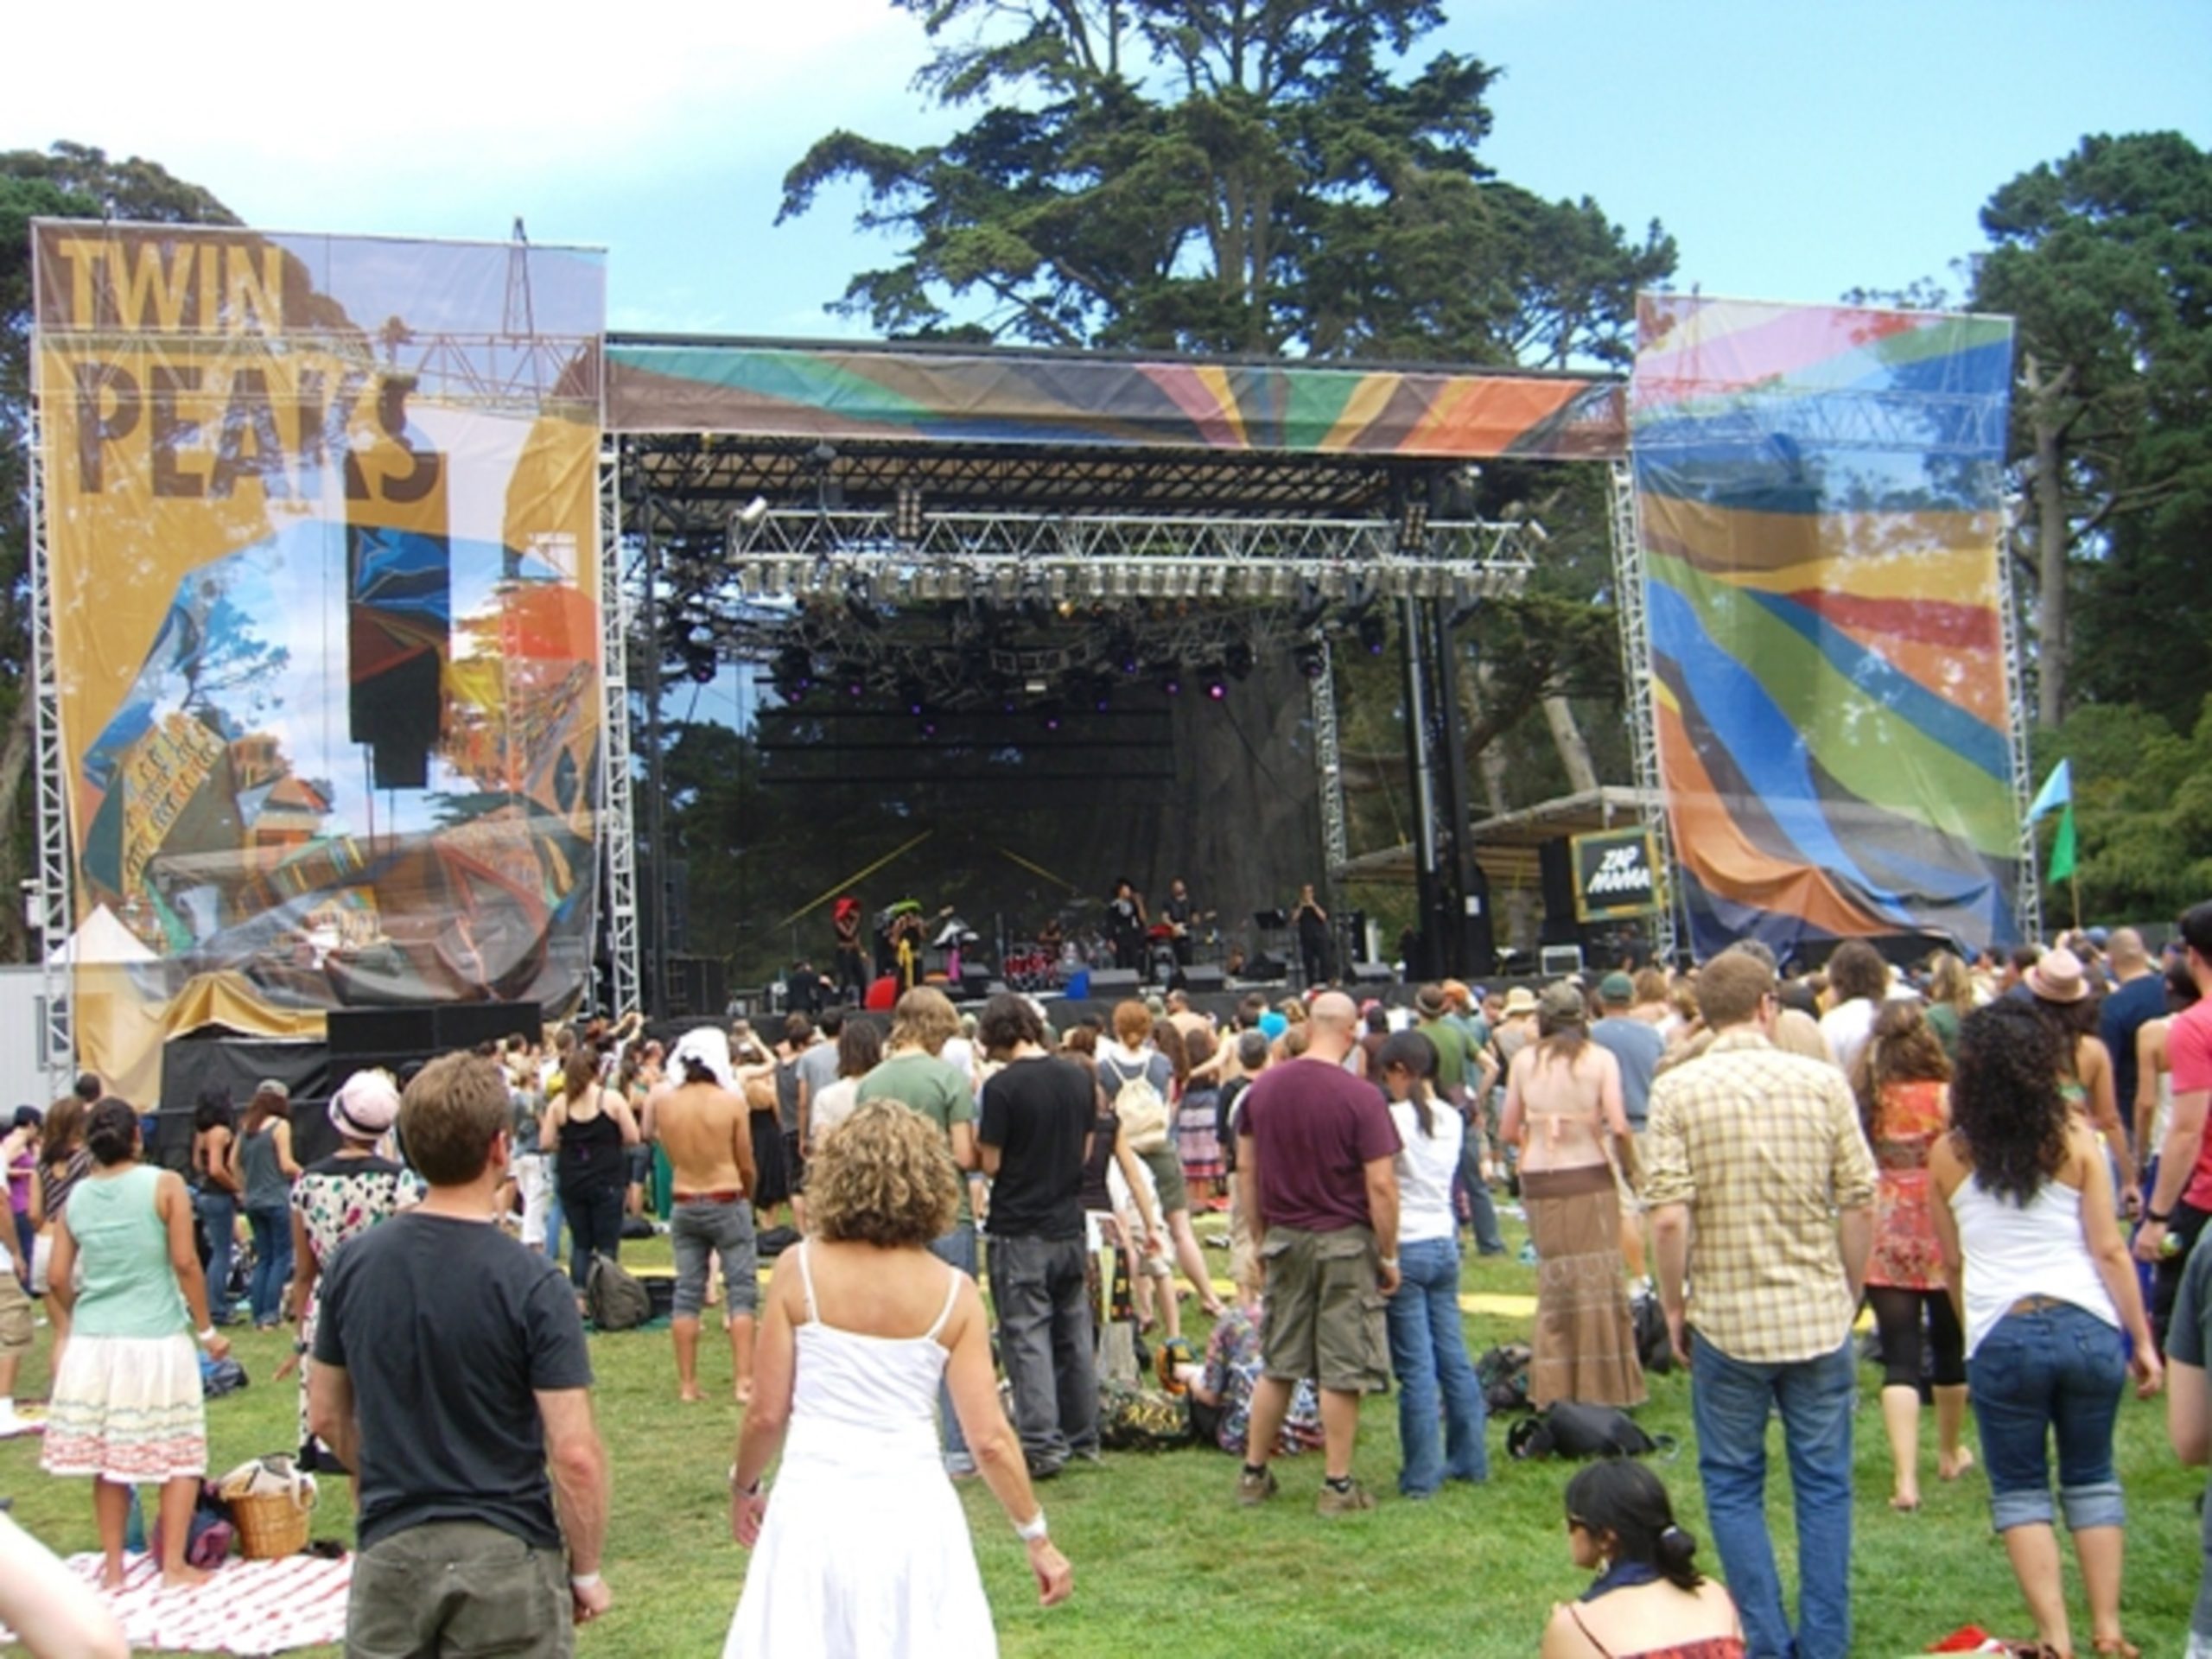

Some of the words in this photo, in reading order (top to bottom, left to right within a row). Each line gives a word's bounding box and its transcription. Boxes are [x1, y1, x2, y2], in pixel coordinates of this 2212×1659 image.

[59, 238, 283, 334] TWIN
[72, 361, 440, 503] PEAKS
[1600, 845, 1639, 870] ZAP
